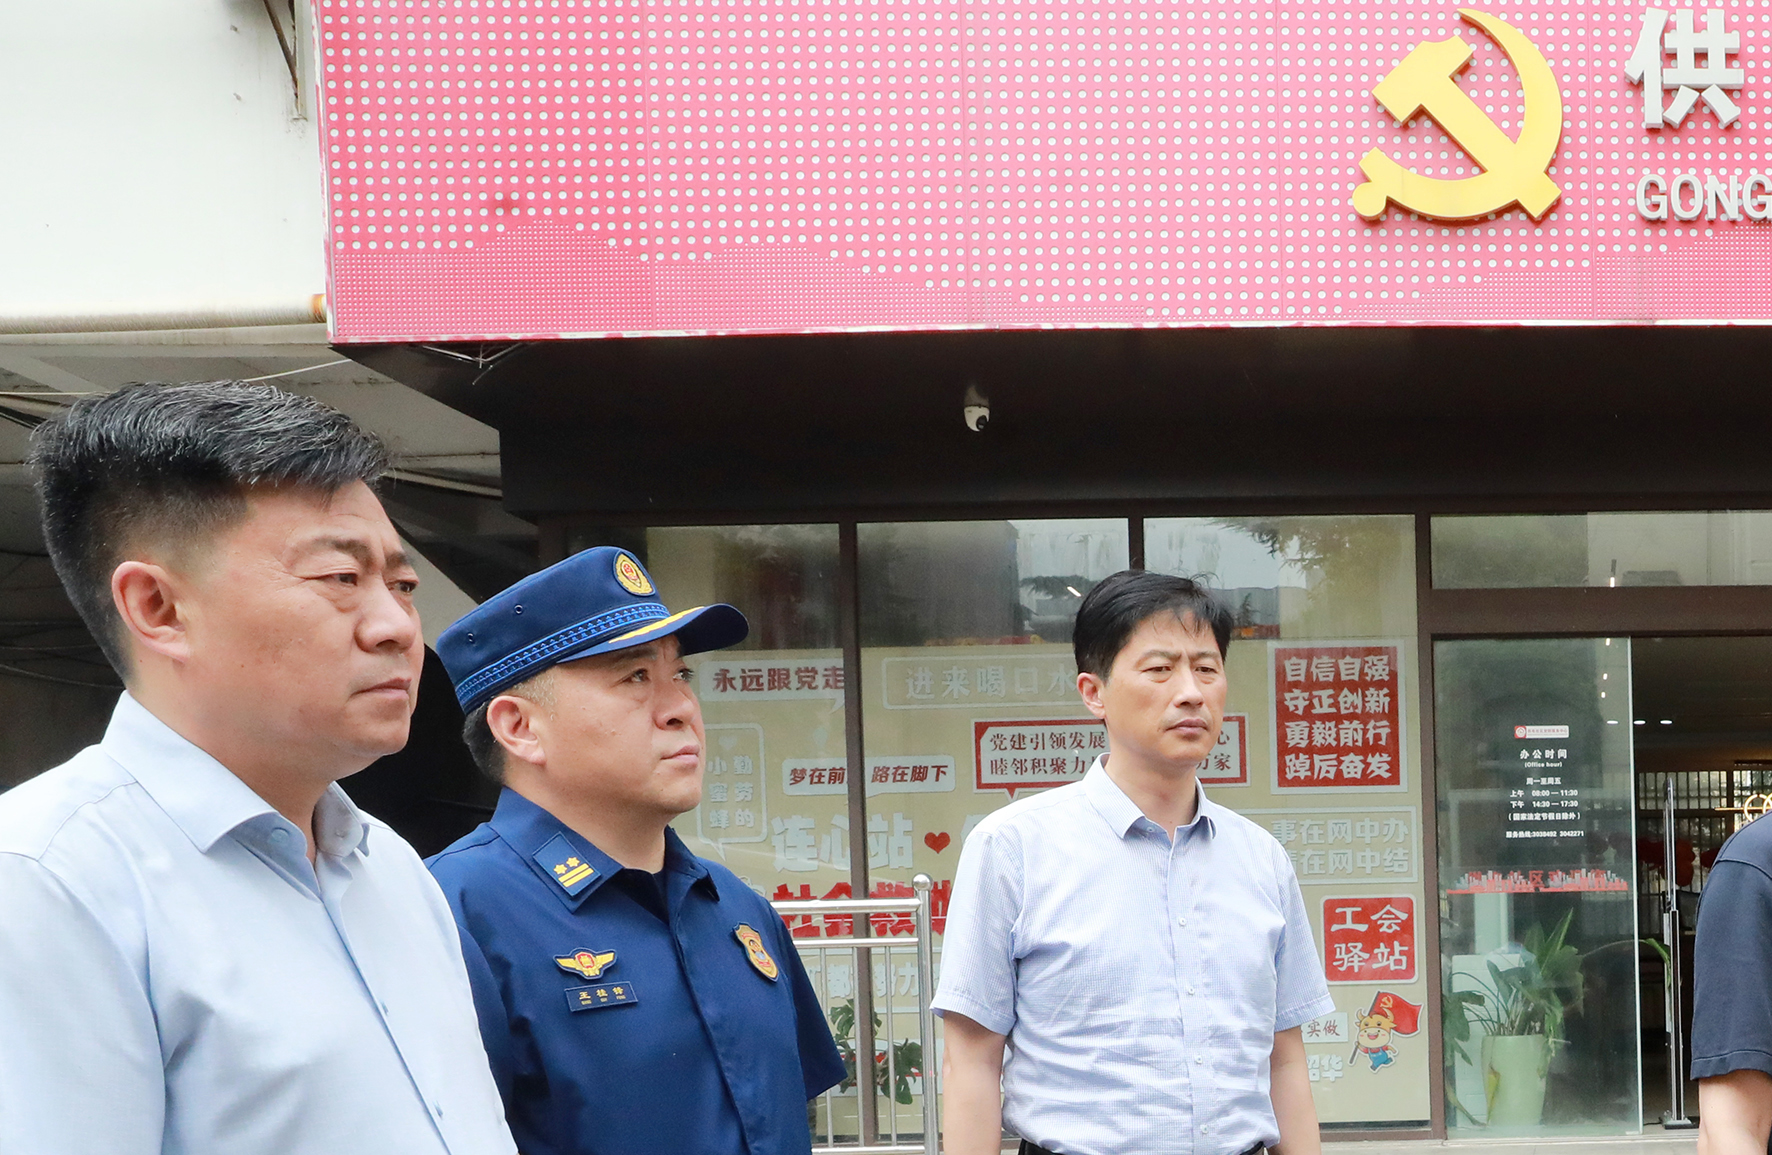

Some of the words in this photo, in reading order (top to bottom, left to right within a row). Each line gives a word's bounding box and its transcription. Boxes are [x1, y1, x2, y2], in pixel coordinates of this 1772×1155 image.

[711, 665, 846, 692] 永远跟党走
[905, 664, 1078, 700] 进来喝口水
[1284, 655, 1390, 682] 自信自强
[1284, 687, 1391, 715] 守正创新
[989, 731, 1107, 752] 党建引领发展
[1285, 719, 1392, 748] 勇毅前行
[1520, 749, 1567, 759] 办公时间
[789, 766, 848, 786] 梦在前
[871, 765, 948, 784] 路在脚下
[1526, 777, 1561, 785] 周一至周五
[1510, 790, 1524, 798] 上午
[1271, 818, 1409, 845] 事在网中办
[1331, 904, 1409, 933] 工会
[1333, 940, 1409, 973] 驿站
